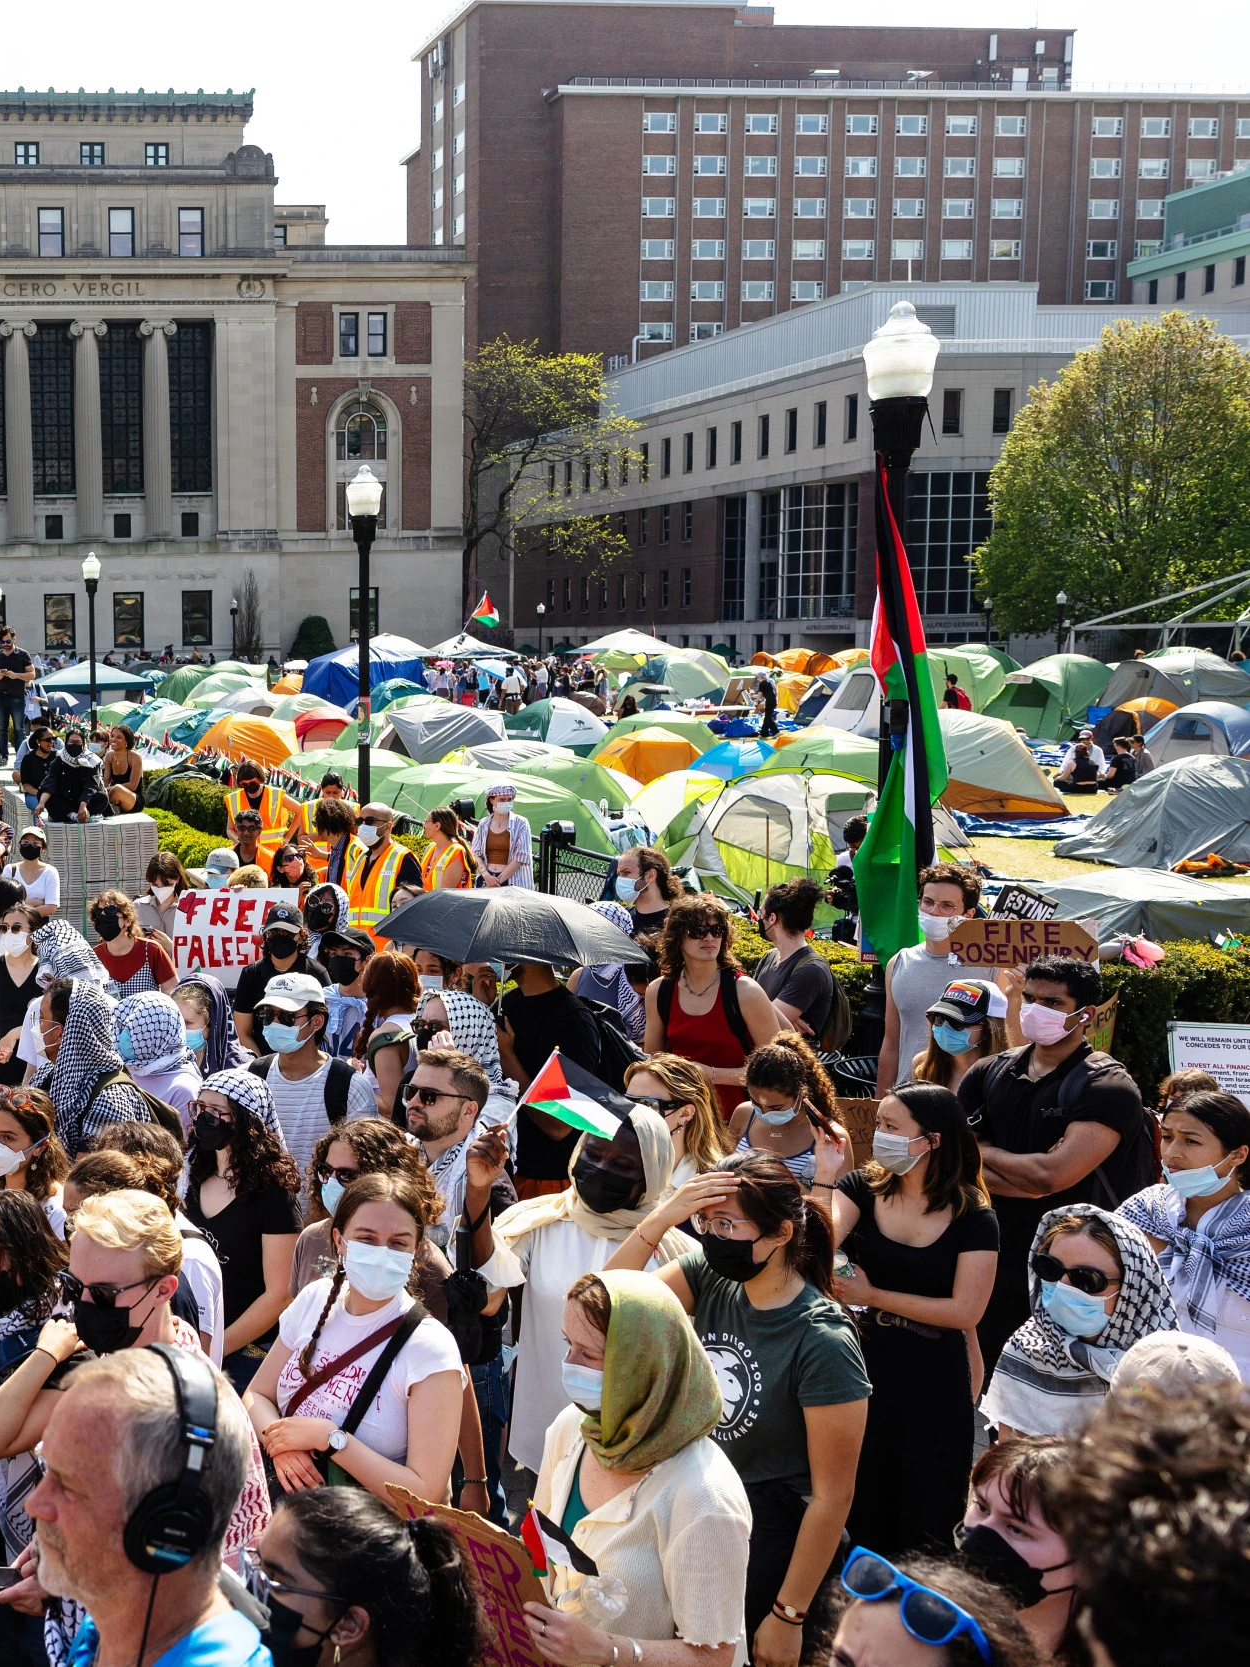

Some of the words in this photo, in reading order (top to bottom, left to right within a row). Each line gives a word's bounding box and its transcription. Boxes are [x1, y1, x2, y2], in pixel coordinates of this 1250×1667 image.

[72, 282, 145, 297] VERGIL
[984, 922, 1061, 945] FIRE
[722, 1332, 752, 1358] DIEGO
[750, 1361, 762, 1392] ZOO
[712, 1410, 758, 1441] ALLIANCE
